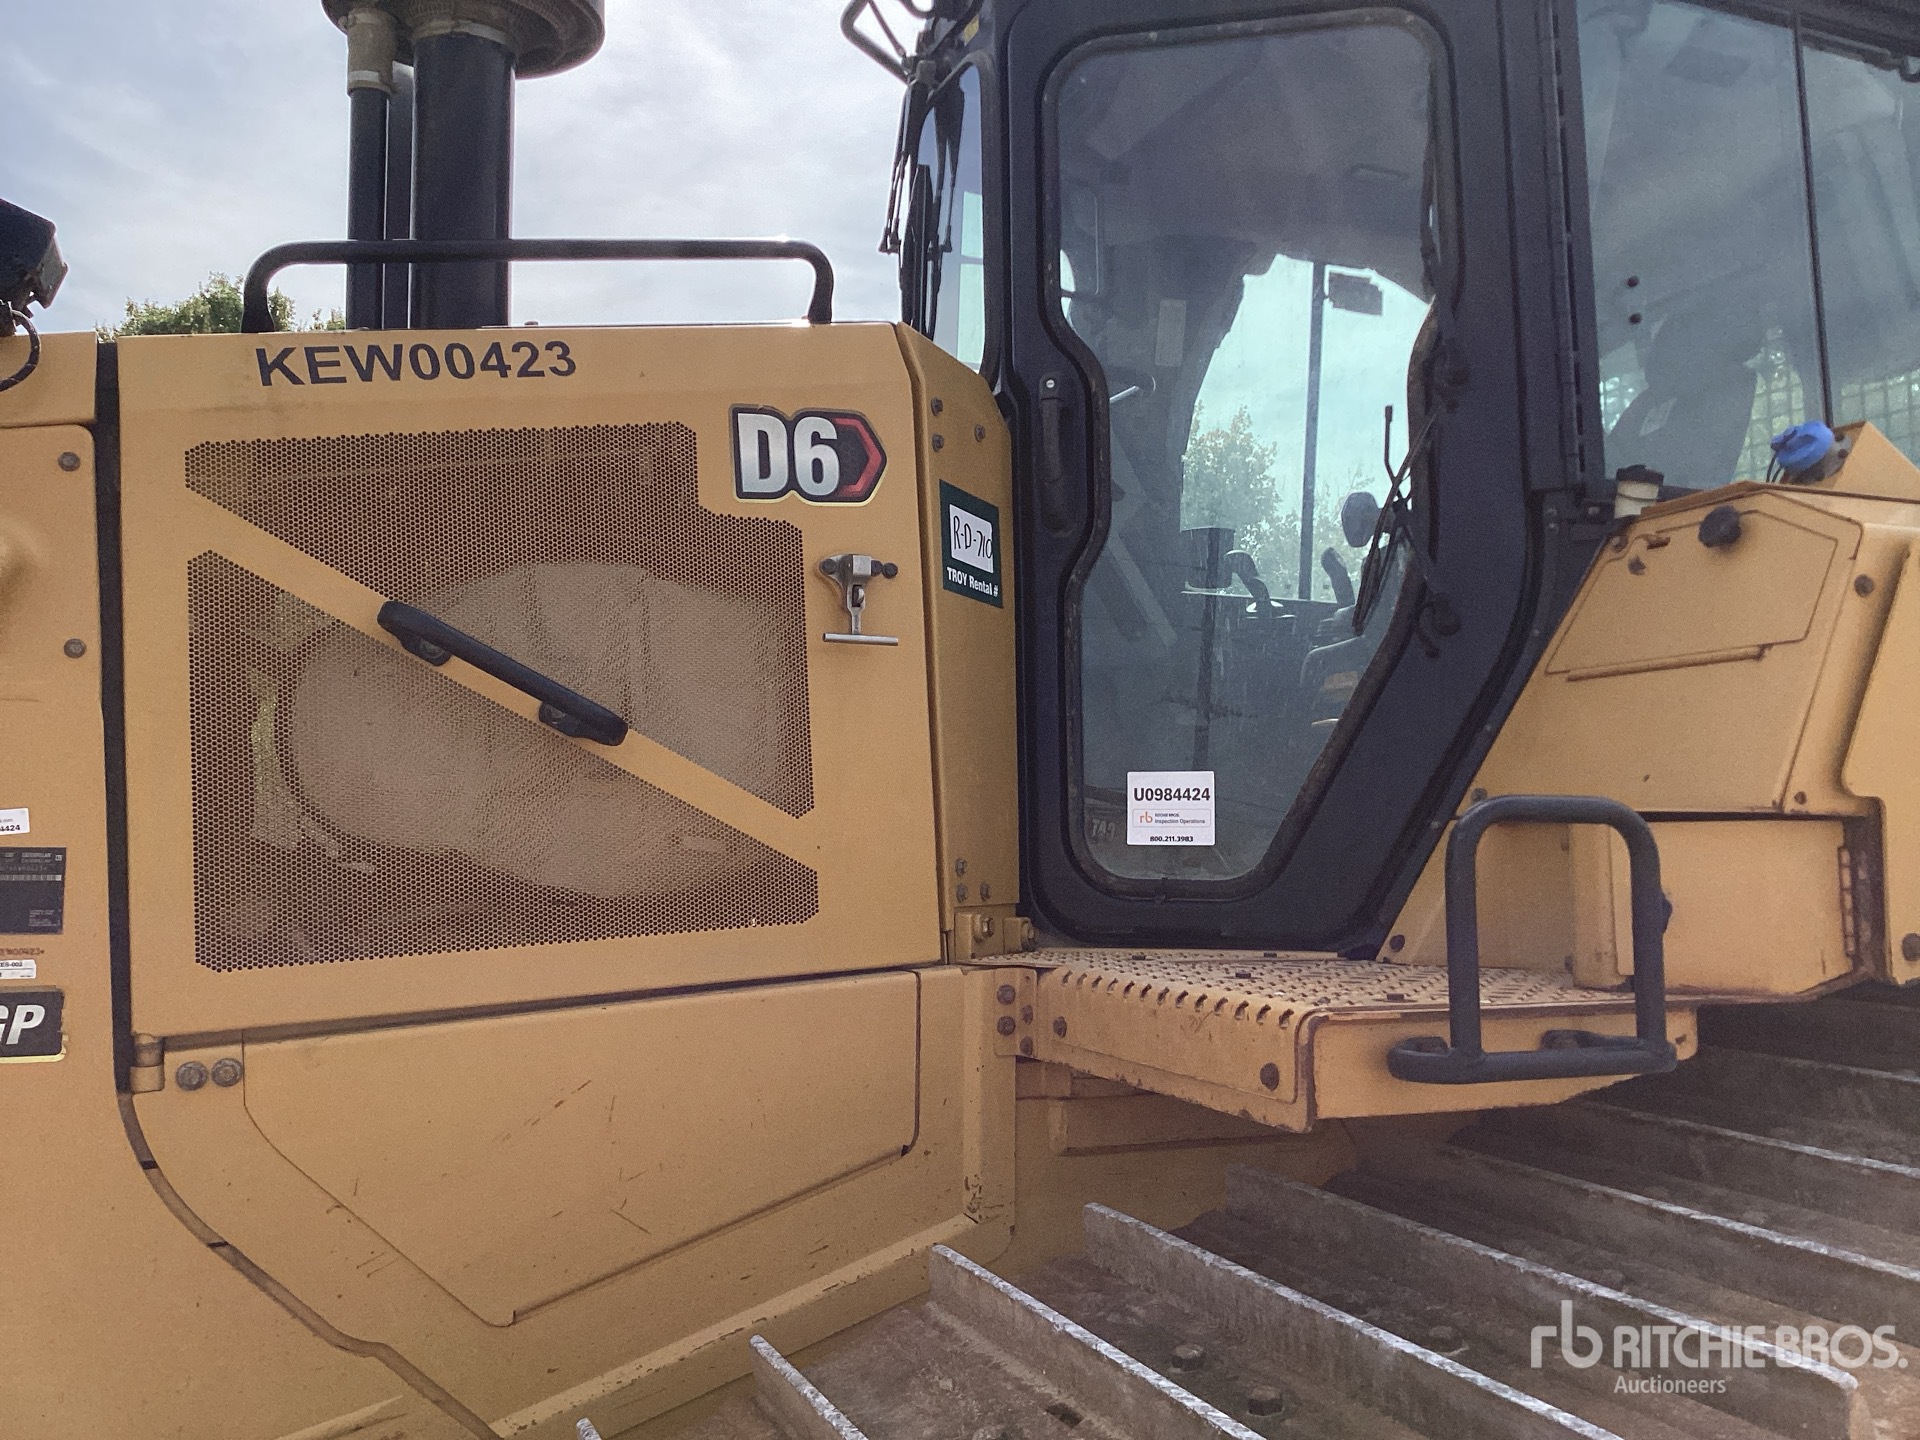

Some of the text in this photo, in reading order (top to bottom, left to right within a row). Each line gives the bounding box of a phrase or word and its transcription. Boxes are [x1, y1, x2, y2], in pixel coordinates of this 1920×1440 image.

[255, 340, 577, 387] KEW00423
[737, 412, 840, 496] D6
[946, 566, 968, 586] TROY
[969, 574, 993, 596] Rental
[1133, 787, 1211, 802] U0984424
[1139, 811, 1153, 824] rb
